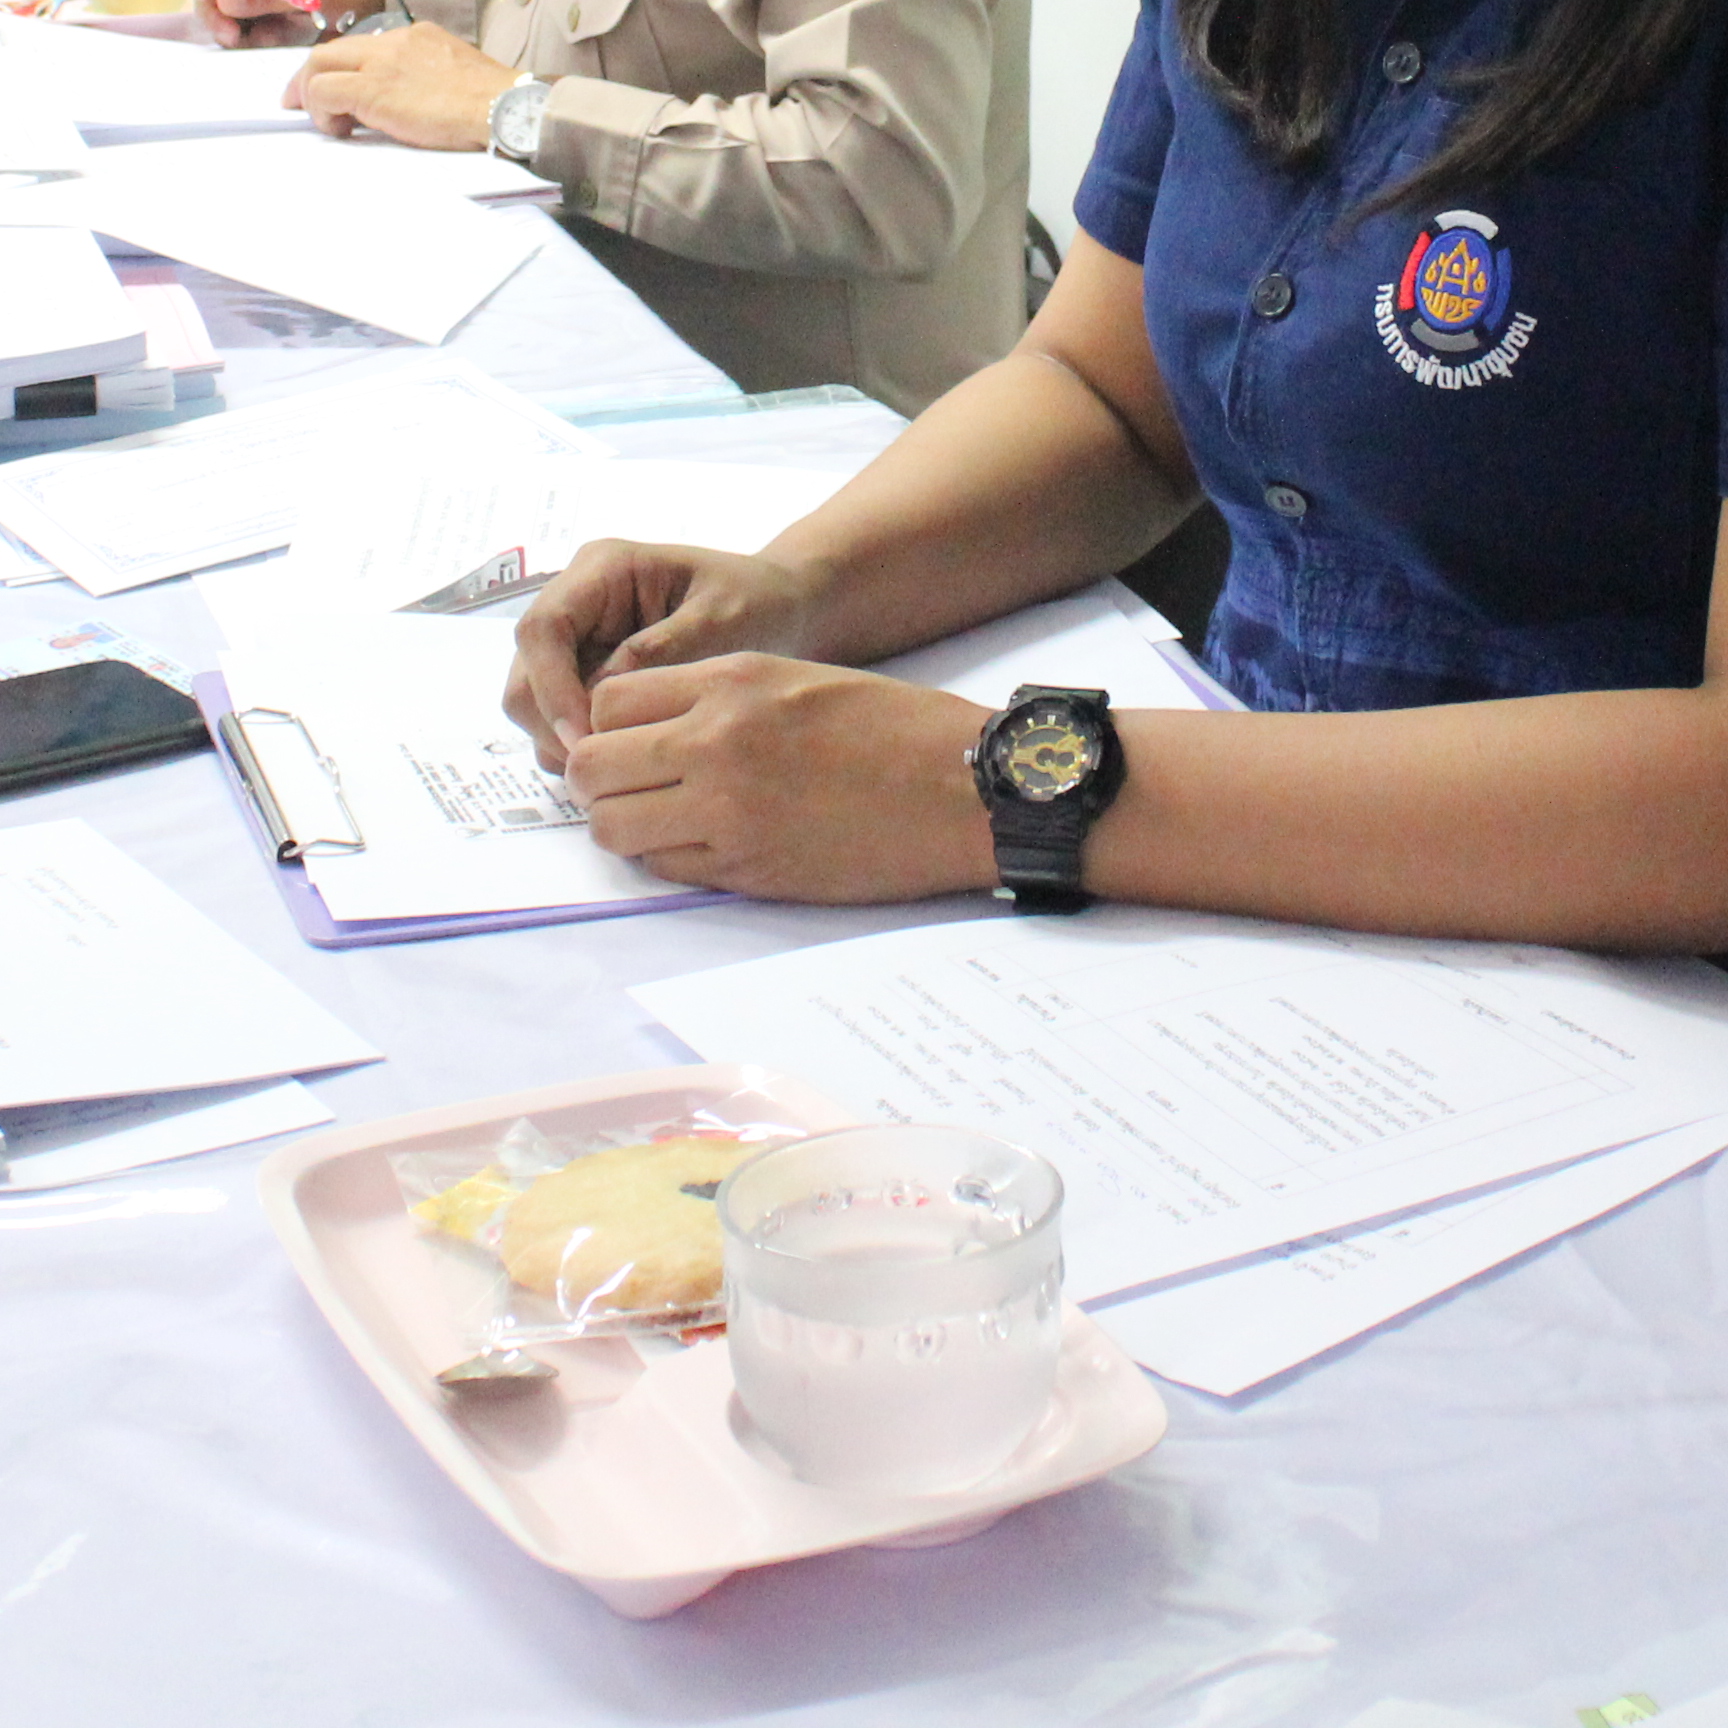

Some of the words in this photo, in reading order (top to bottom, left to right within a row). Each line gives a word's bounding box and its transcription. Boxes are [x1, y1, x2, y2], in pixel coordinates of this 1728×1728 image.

[1374, 283, 1538, 390] กรมการพัฒนาชุมชน
